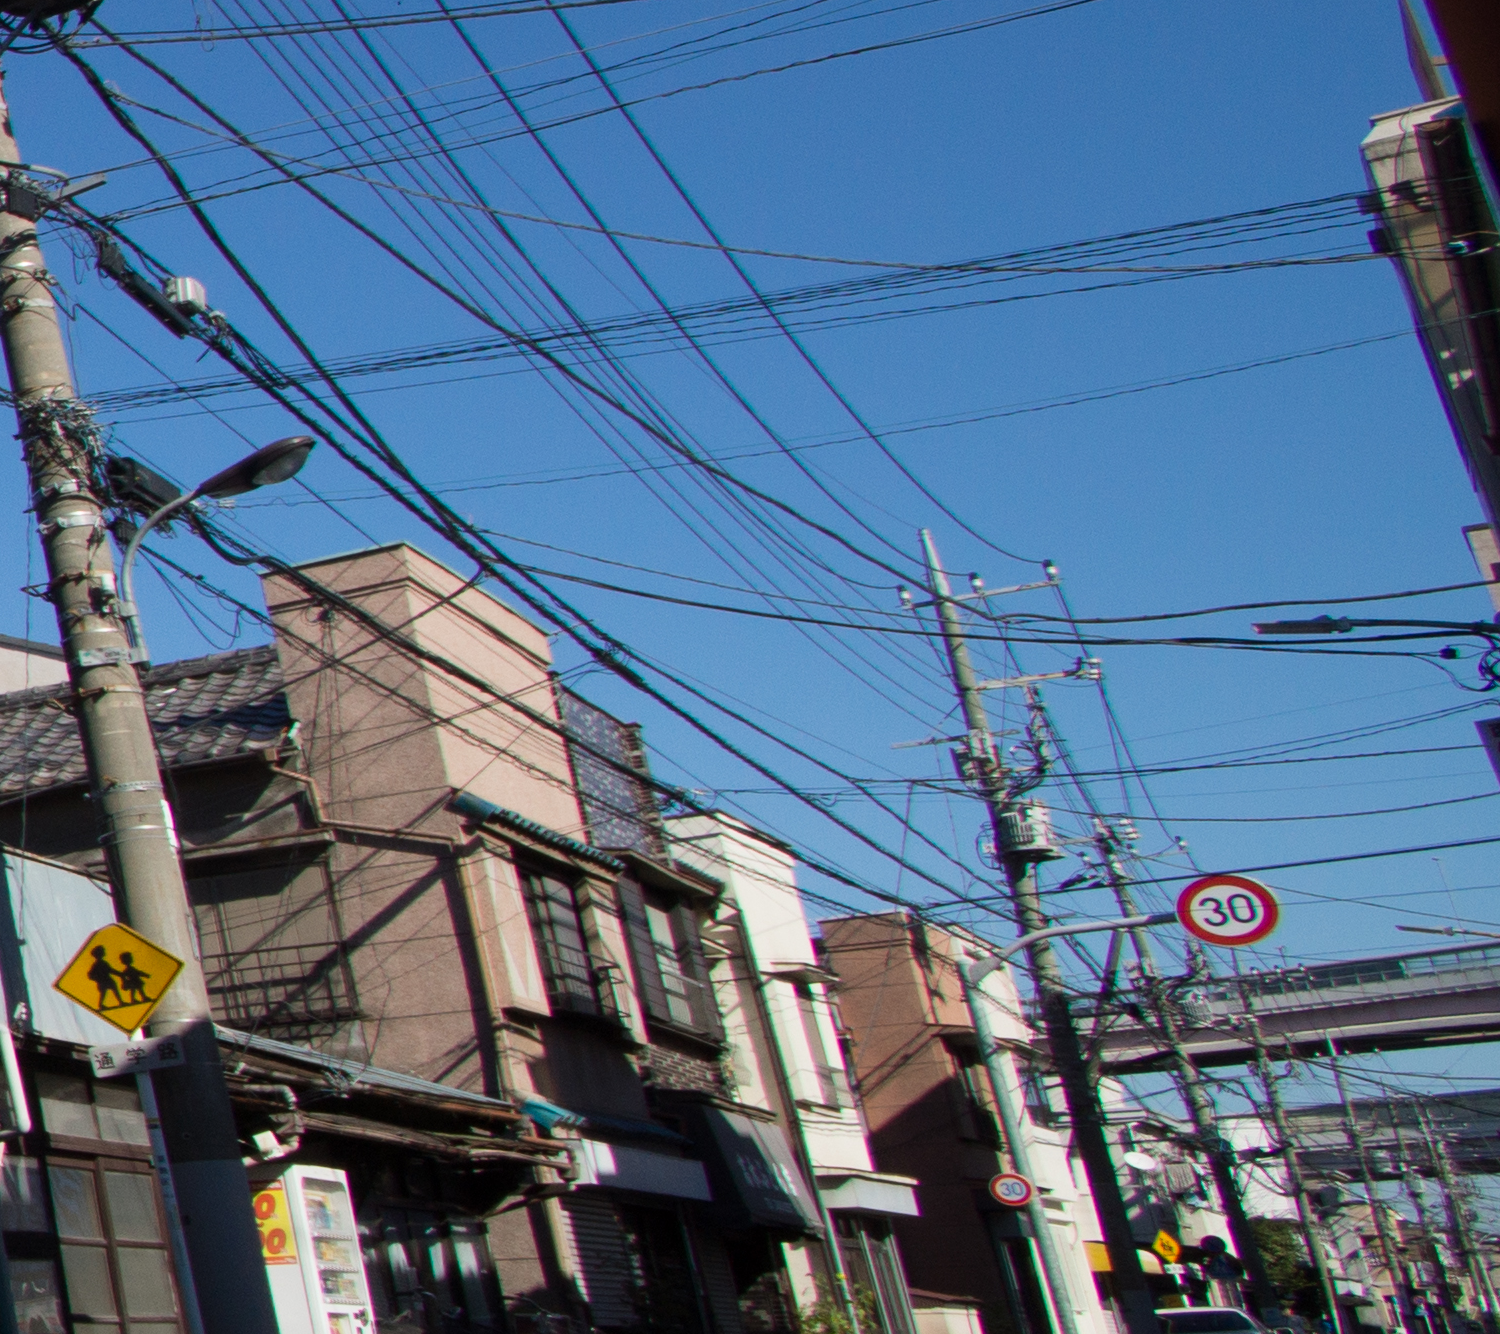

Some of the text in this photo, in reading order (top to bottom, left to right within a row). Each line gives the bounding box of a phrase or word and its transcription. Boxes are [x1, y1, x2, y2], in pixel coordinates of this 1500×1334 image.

[1198, 894, 1258, 928] 30
[93, 1042, 180, 1071] 通学路
[999, 1178, 1026, 1199] 30
